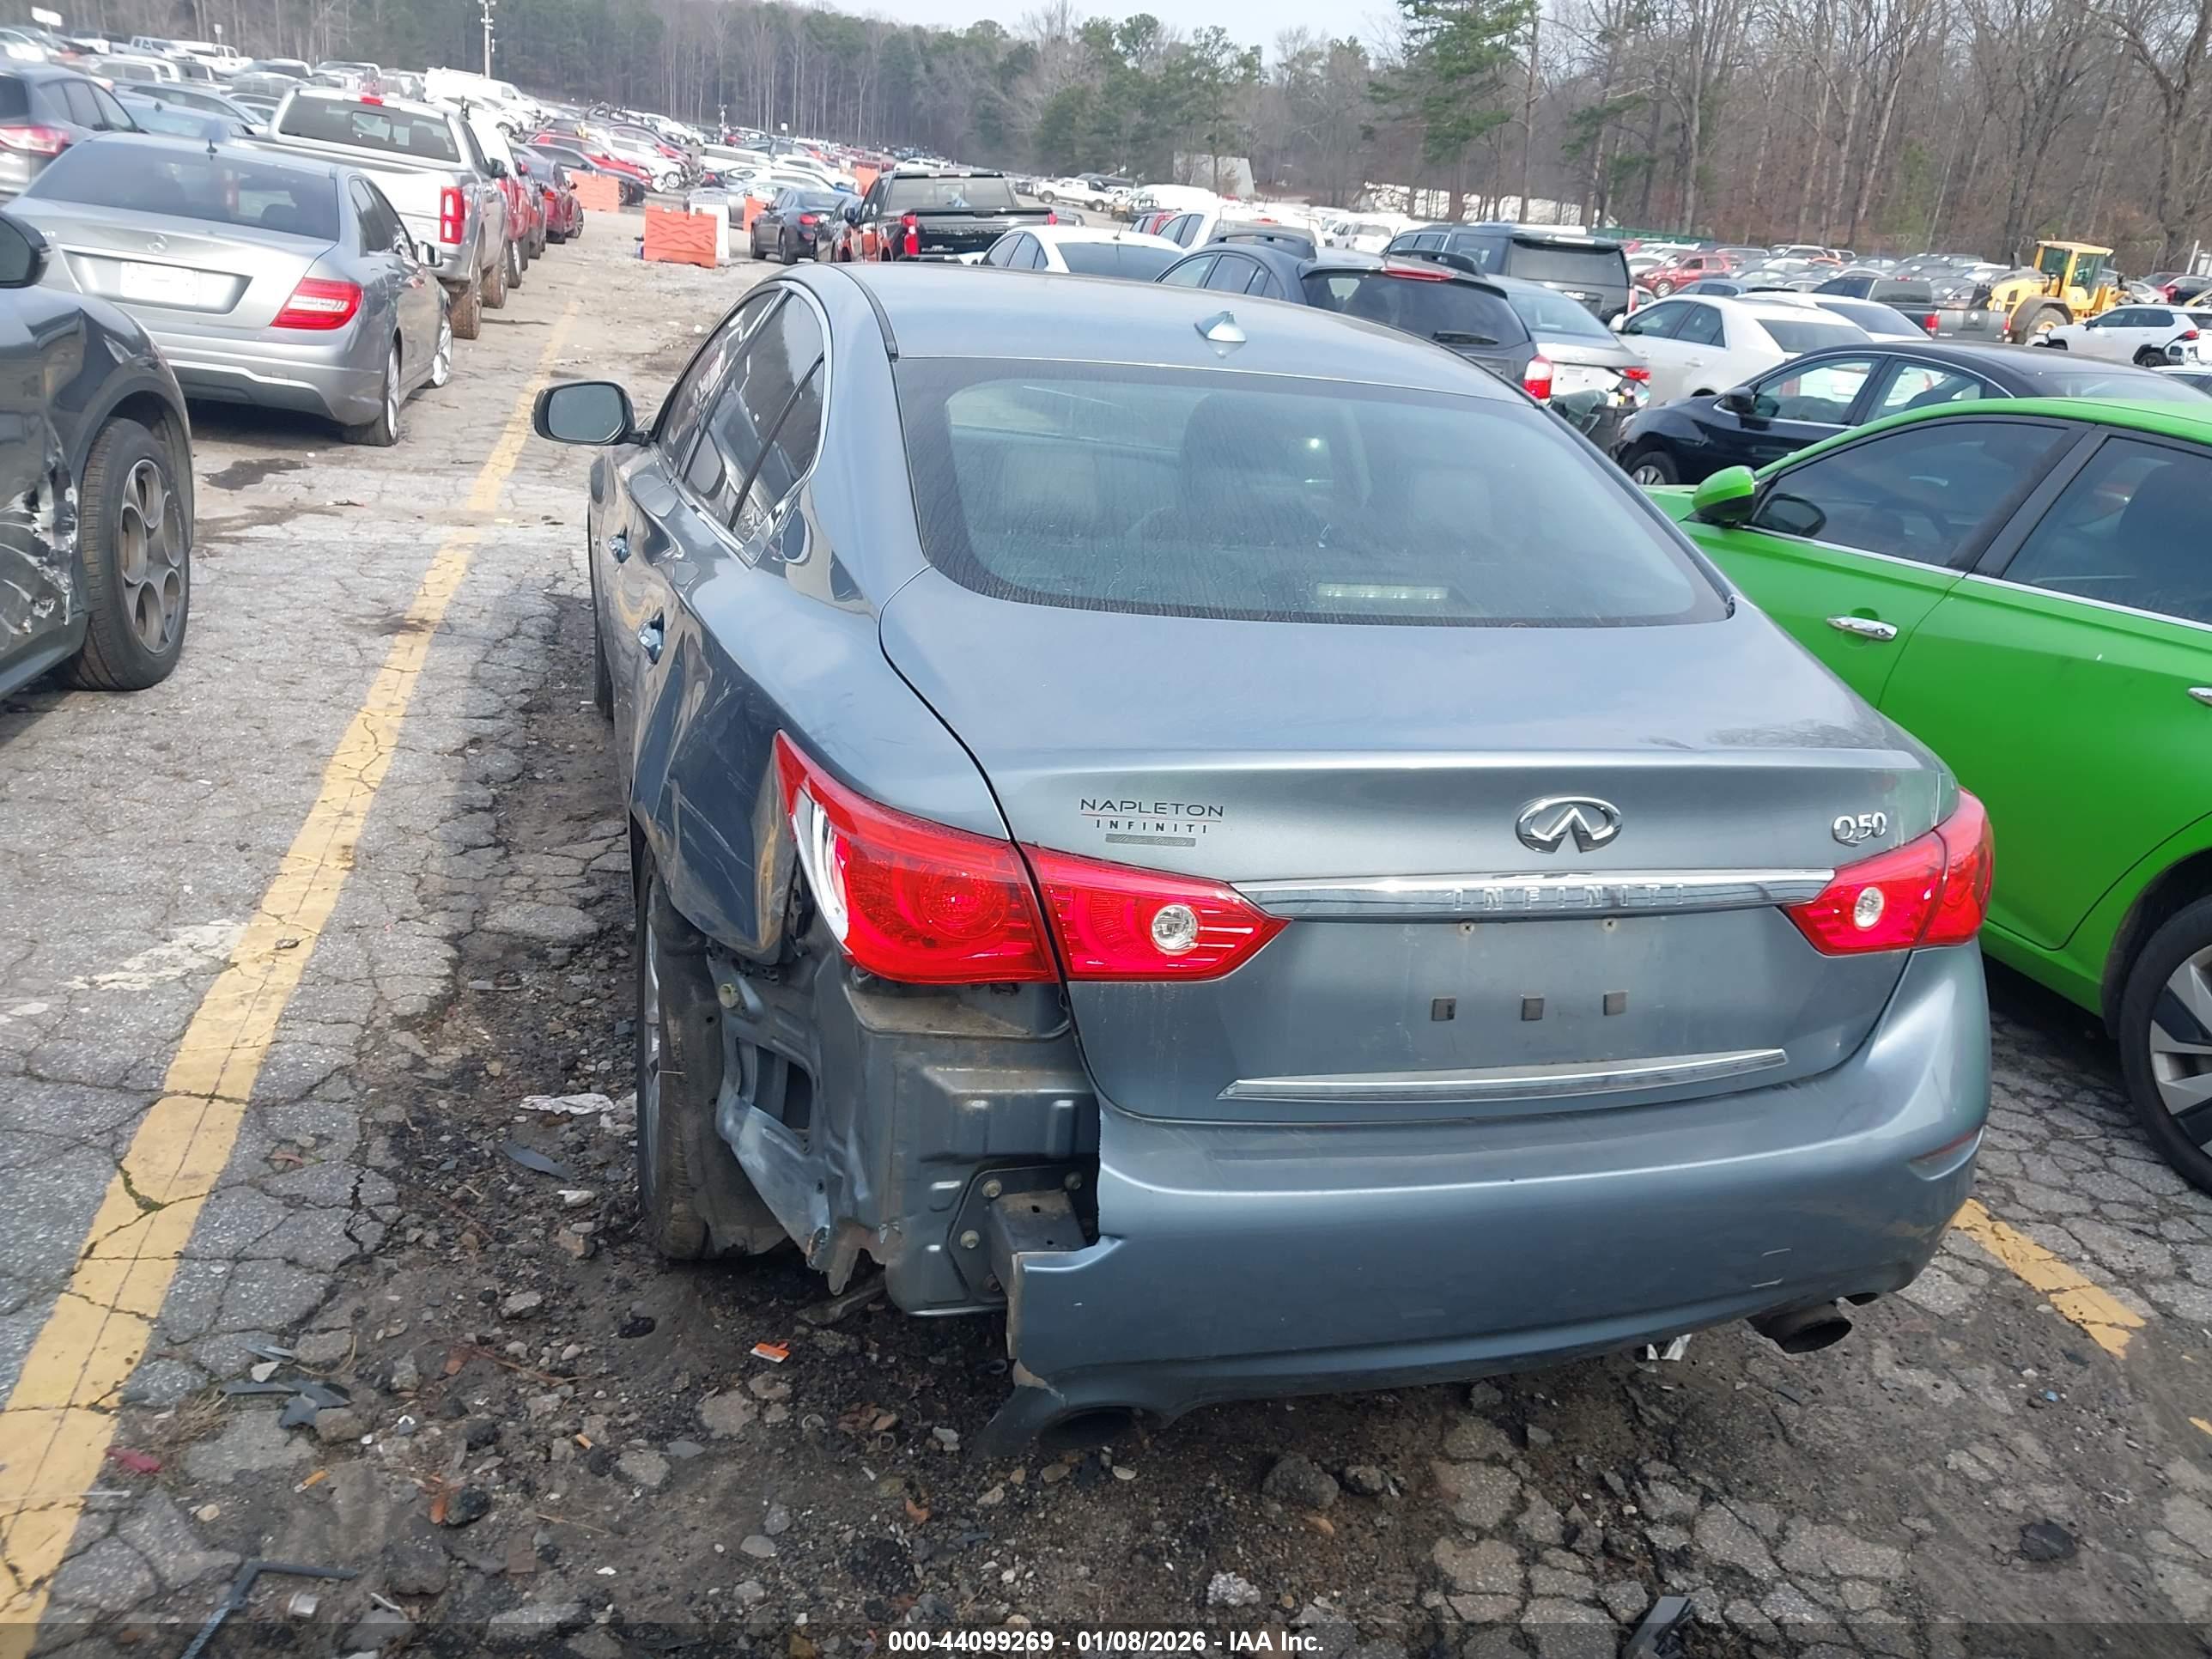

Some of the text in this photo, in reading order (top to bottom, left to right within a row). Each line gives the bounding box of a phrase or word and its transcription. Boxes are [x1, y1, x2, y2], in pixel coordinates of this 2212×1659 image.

[1080, 799, 1224, 817] NAPLETON
[1096, 819, 1207, 834] INFINITI
[1832, 811, 1887, 848] Q50
[1453, 883, 1686, 911] INFINITI
